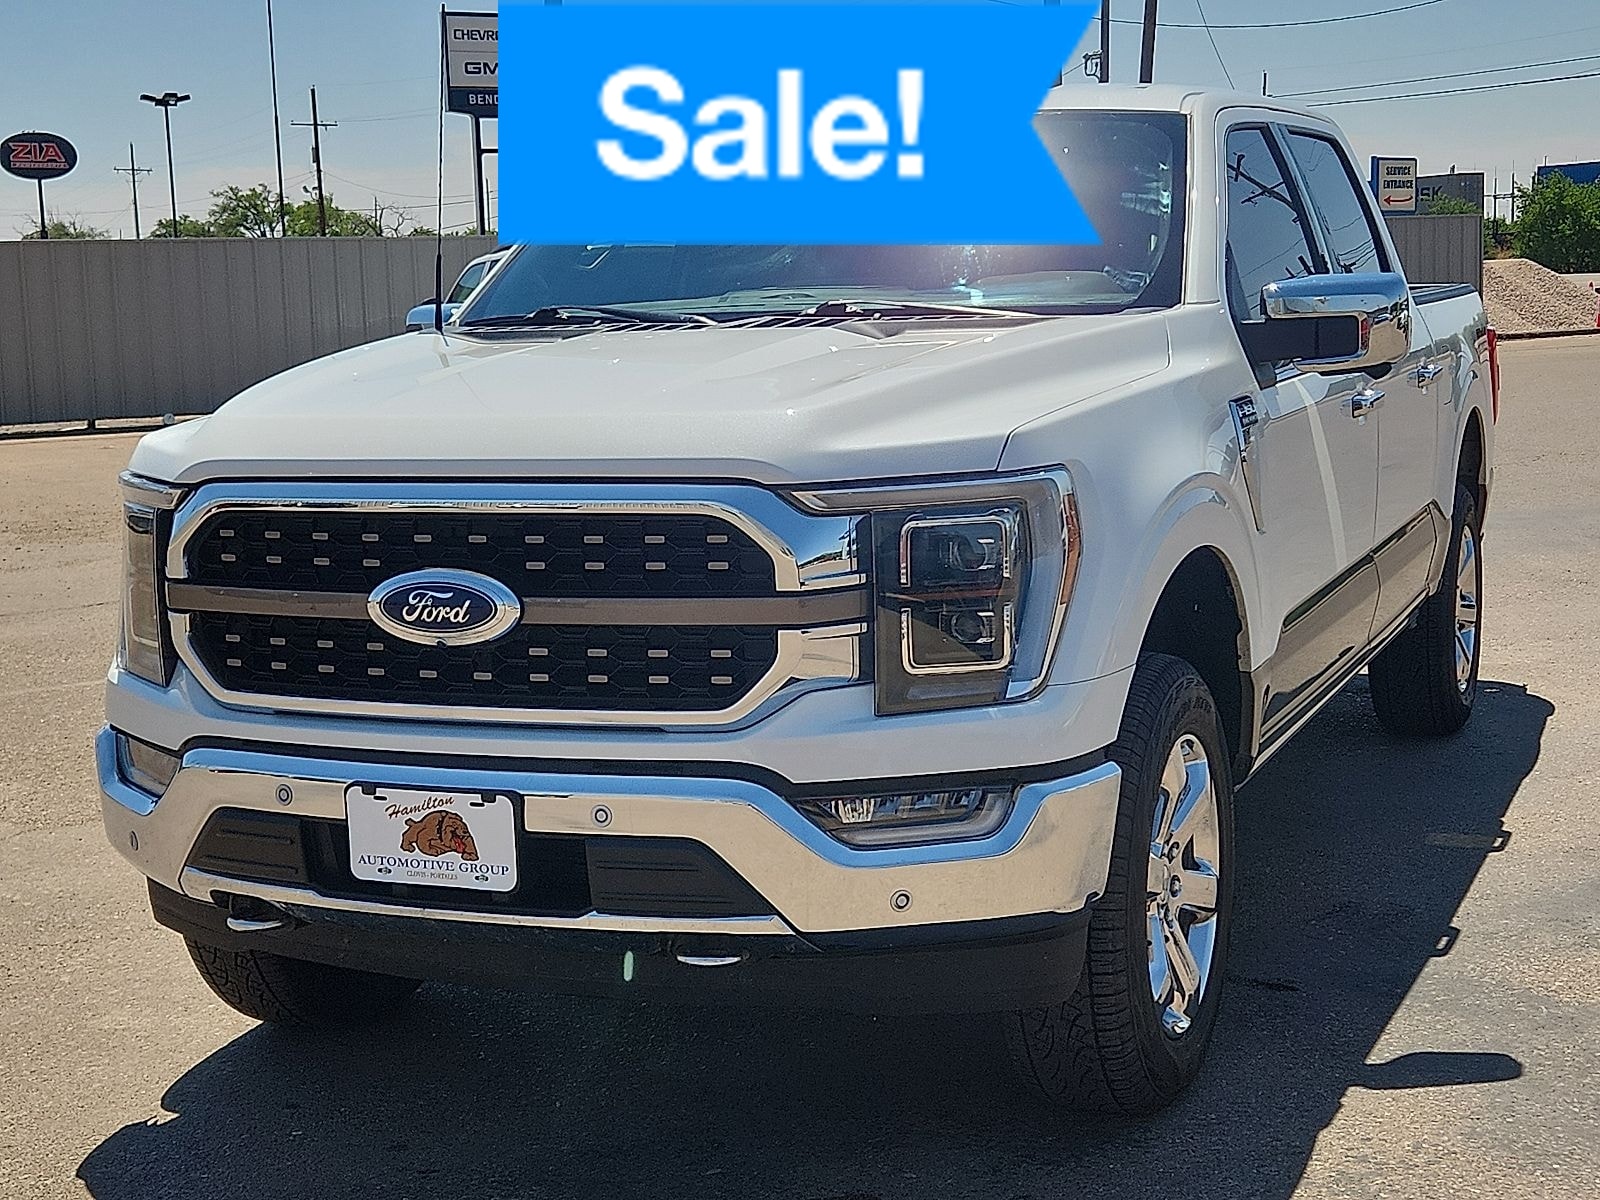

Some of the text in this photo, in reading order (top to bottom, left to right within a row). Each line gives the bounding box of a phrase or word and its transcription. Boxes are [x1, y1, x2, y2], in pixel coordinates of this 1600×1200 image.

[8, 142, 66, 162] ZIA
[1385, 165, 1411, 176] SERVICE
[1383, 179, 1414, 189] ENTRANCE
[402, 589, 471, 623] Ford
[385, 795, 455, 819] Hamilton
[358, 854, 509, 876] AUTOMOTIVE GROUP
